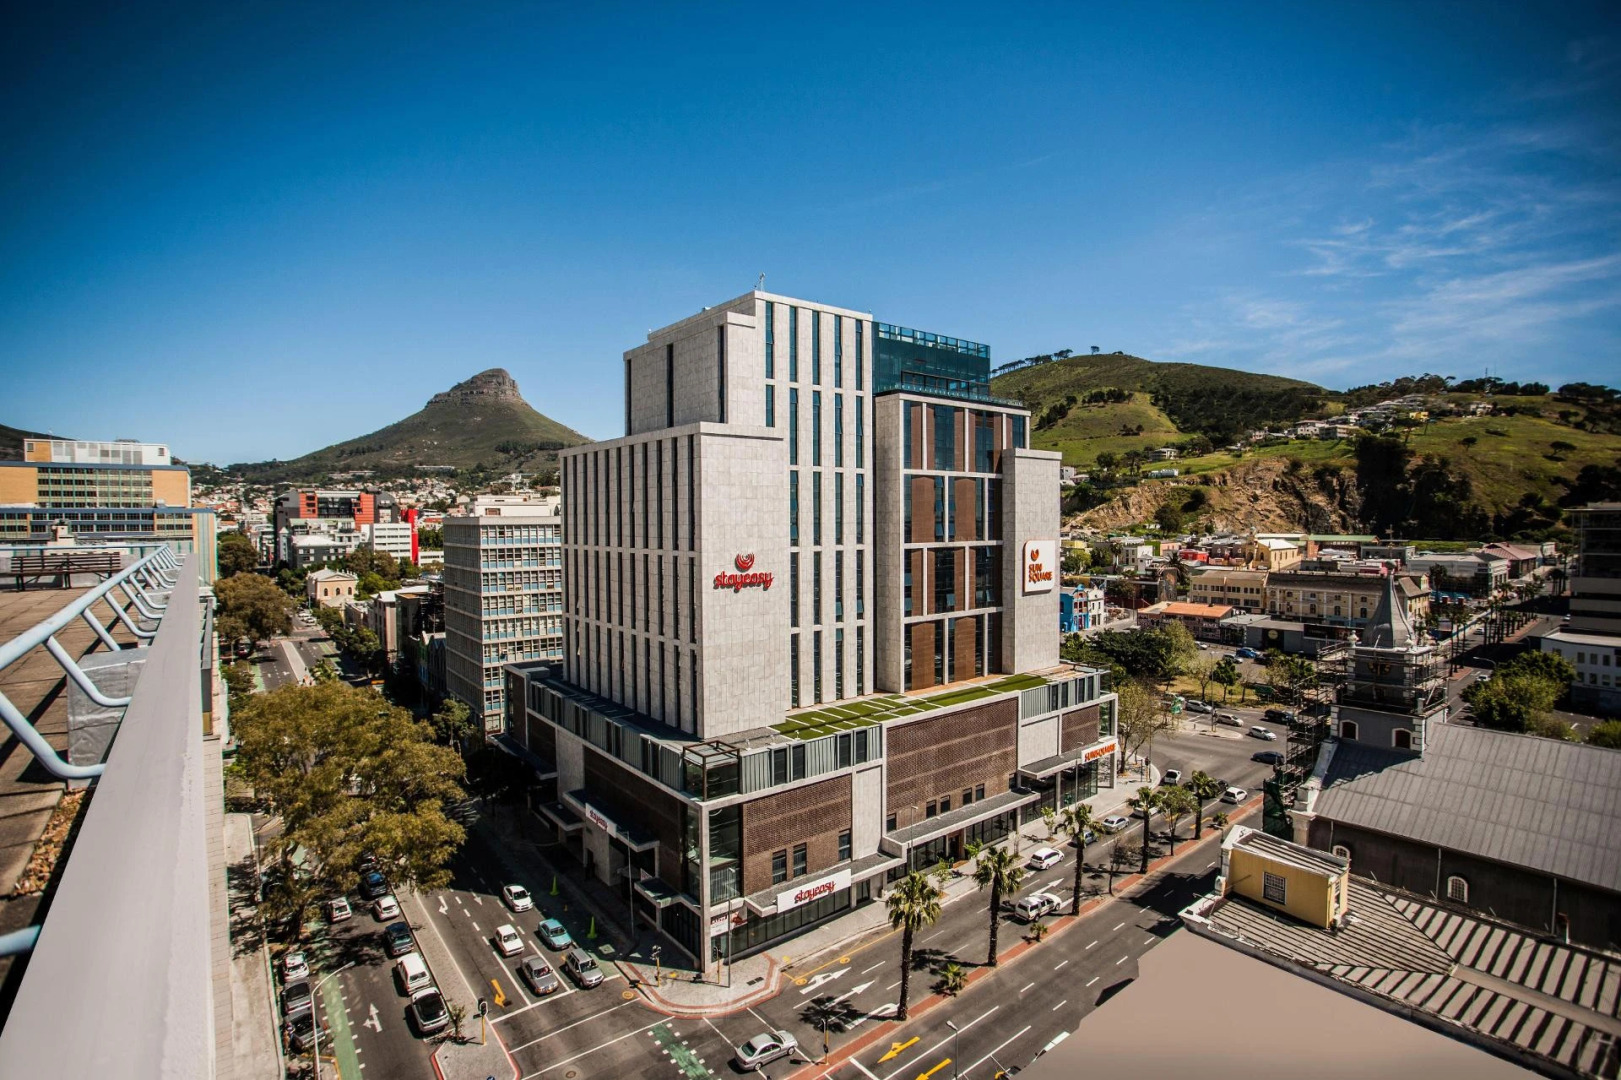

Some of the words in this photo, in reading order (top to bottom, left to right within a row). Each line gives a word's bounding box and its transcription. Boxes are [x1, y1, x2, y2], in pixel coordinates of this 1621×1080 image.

[1029, 563, 1042, 572] SUN
[714, 571, 774, 590] stayeasy
[1029, 571, 1052, 583] SQUARE
[794, 881, 836, 904] stayeasy
